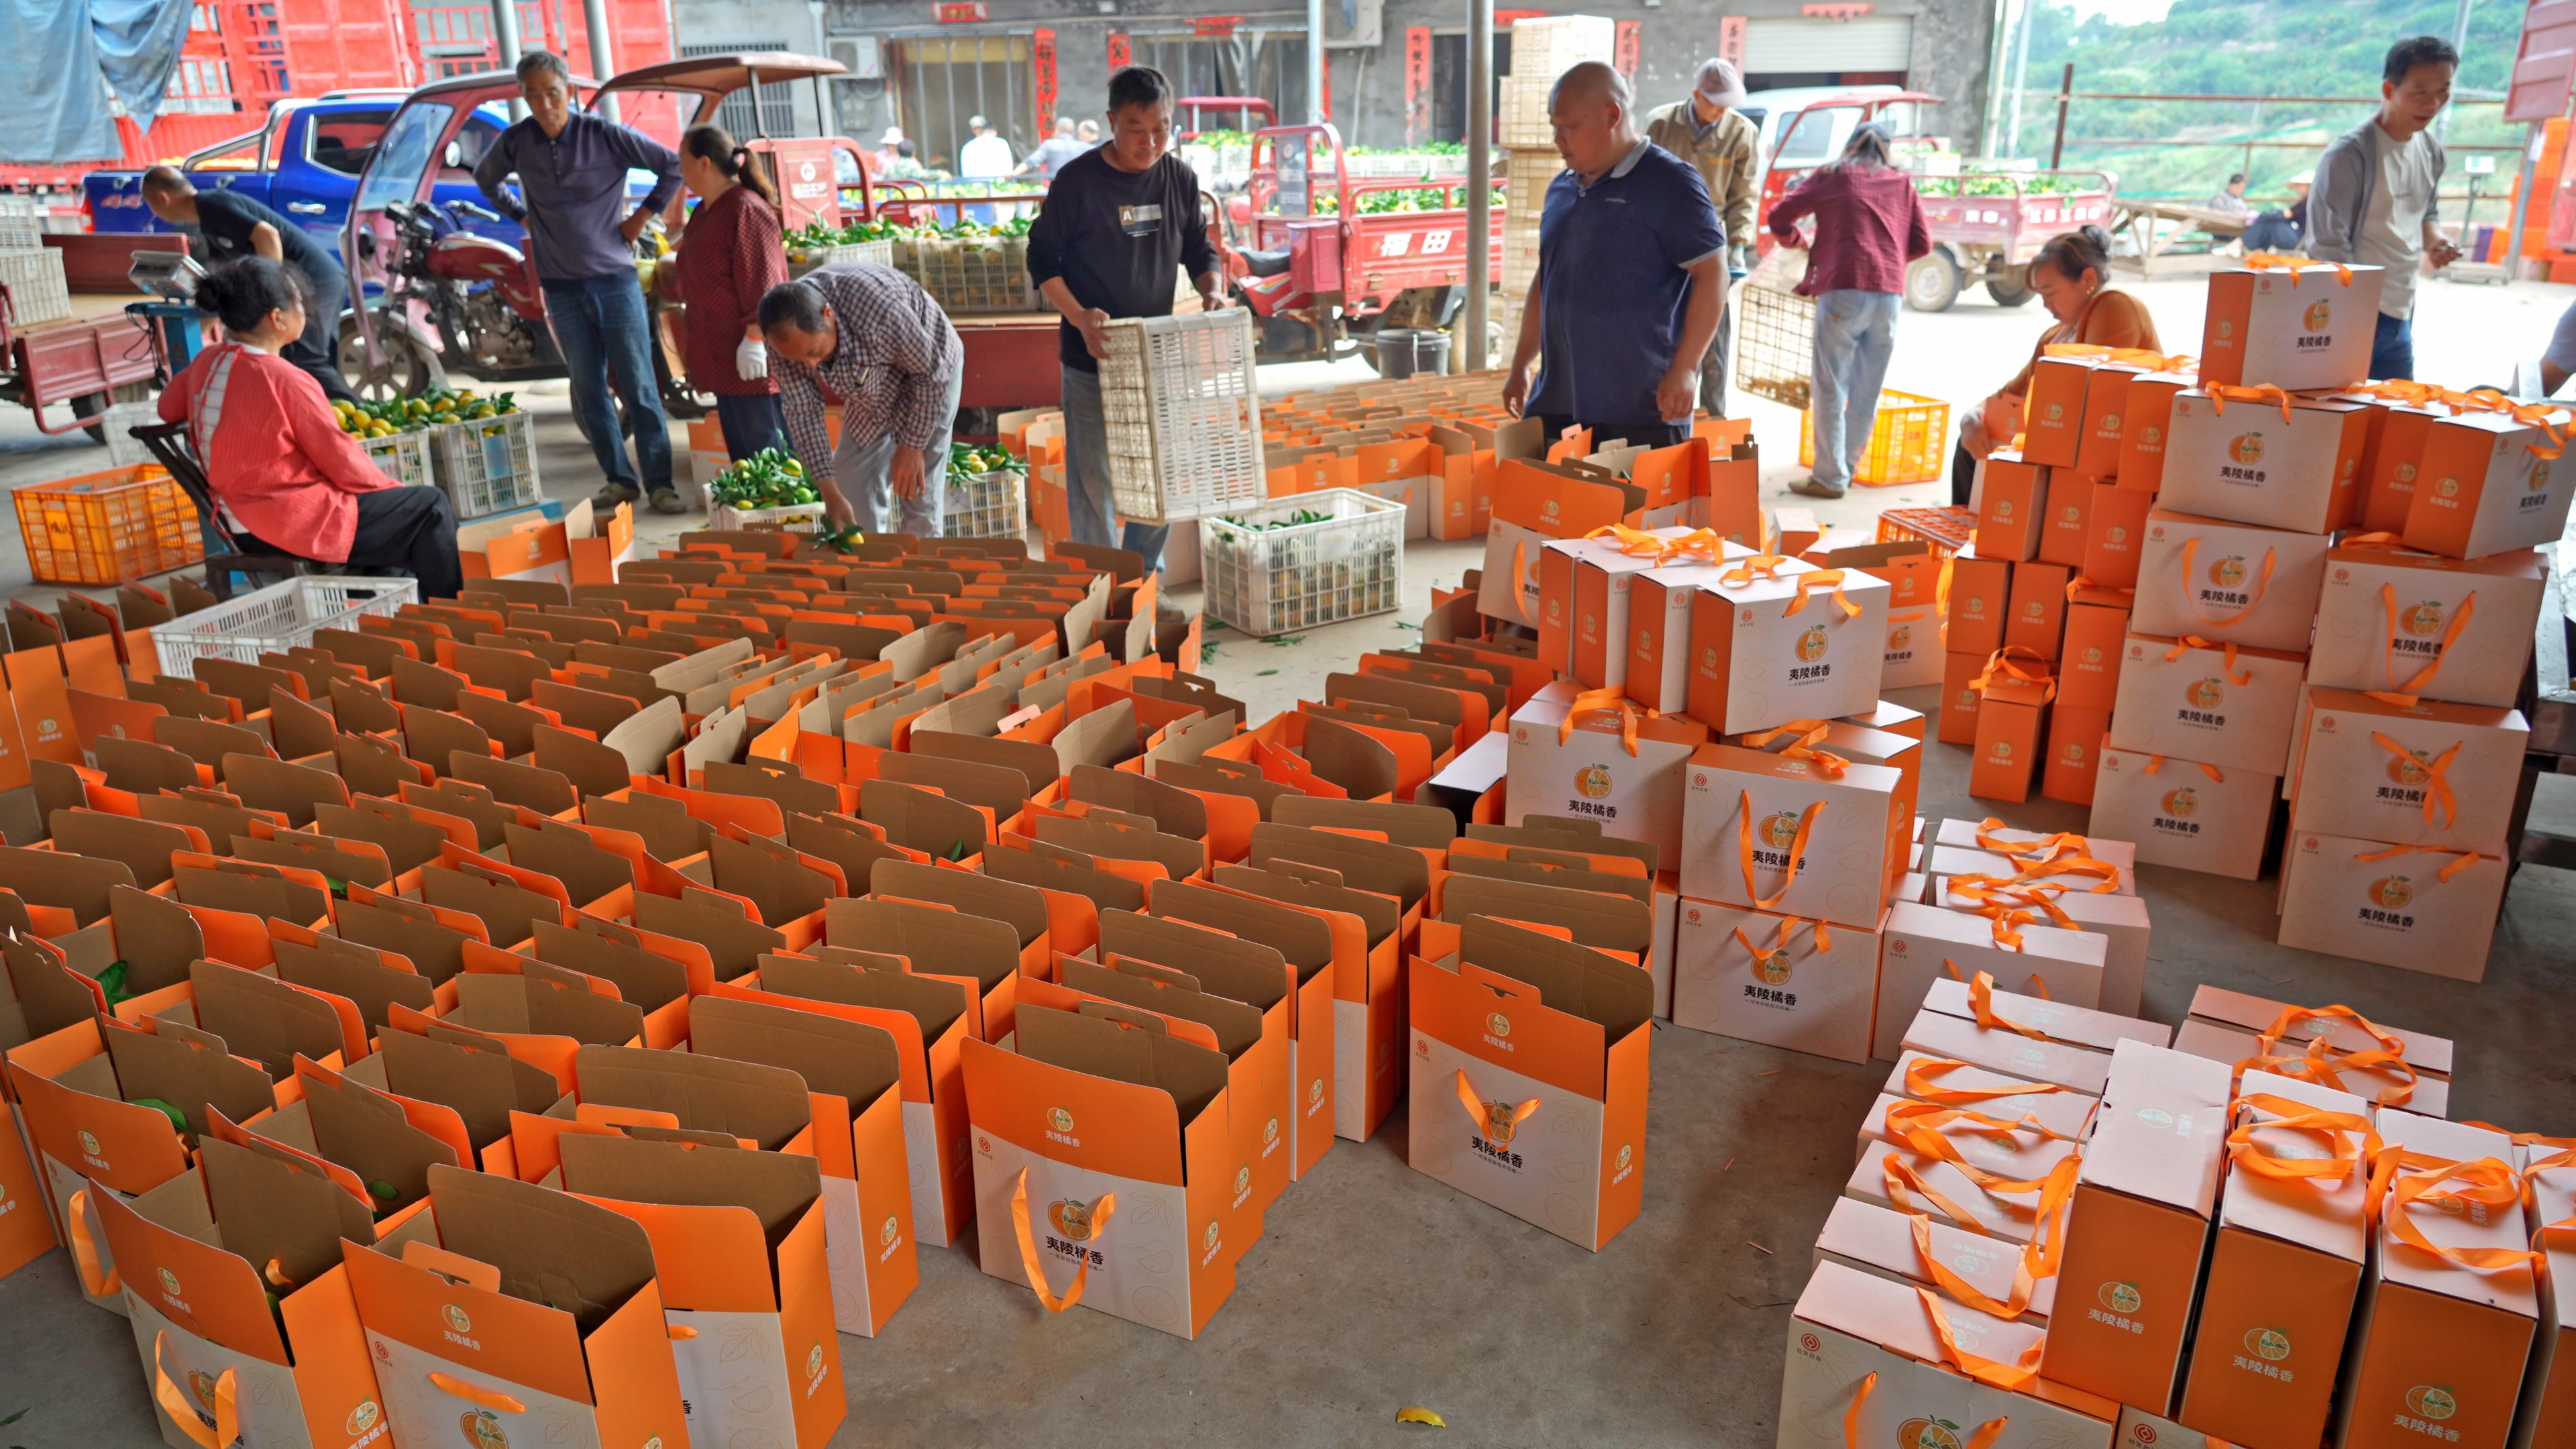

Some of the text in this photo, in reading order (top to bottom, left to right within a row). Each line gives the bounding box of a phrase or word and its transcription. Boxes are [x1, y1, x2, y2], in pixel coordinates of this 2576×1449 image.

[1381, 230, 1452, 257] 福田
[2296, 336, 2332, 348] 夷陵橘香
[2220, 466, 2266, 482] 夷陵橘香
[2200, 590, 2249, 604] 夷陵橘香
[2392, 637, 2444, 655] 夷陵橘香
[1788, 664, 1831, 681] 夷陵橘香
[2178, 709, 2225, 727] 夷陵橘香
[1568, 799, 1617, 818] 夷陵橘香
[2153, 818, 2200, 834] 夷陵橘香
[1753, 850, 1806, 869] 夷陵橘香
[2358, 908, 2414, 928] 夷陵橘香
[1744, 985, 1797, 1006] 夷陵橘香
[1483, 1034, 1515, 1052] 夷陵橘香
[1046, 1129, 1080, 1147] 夷陵橘香
[1472, 1136, 1523, 1168] 夷陵橘香
[1613, 1166, 1633, 1186] 夷陵橘香
[2471, 1200, 2487, 1226] 夷陵橘
[880, 1237, 902, 1263] 夷陵橘香
[1046, 1236, 1104, 1265] 夷陵橘香
[2088, 1307, 2145, 1334] 夷陵橘香
[443, 1331, 481, 1351] 夷陵橘香
[2233, 1354, 2294, 1383] 夷陵橘香
[808, 1363, 828, 1399] 夷陵橘香
[2394, 1413, 2460, 1443] 夷陵橘香
